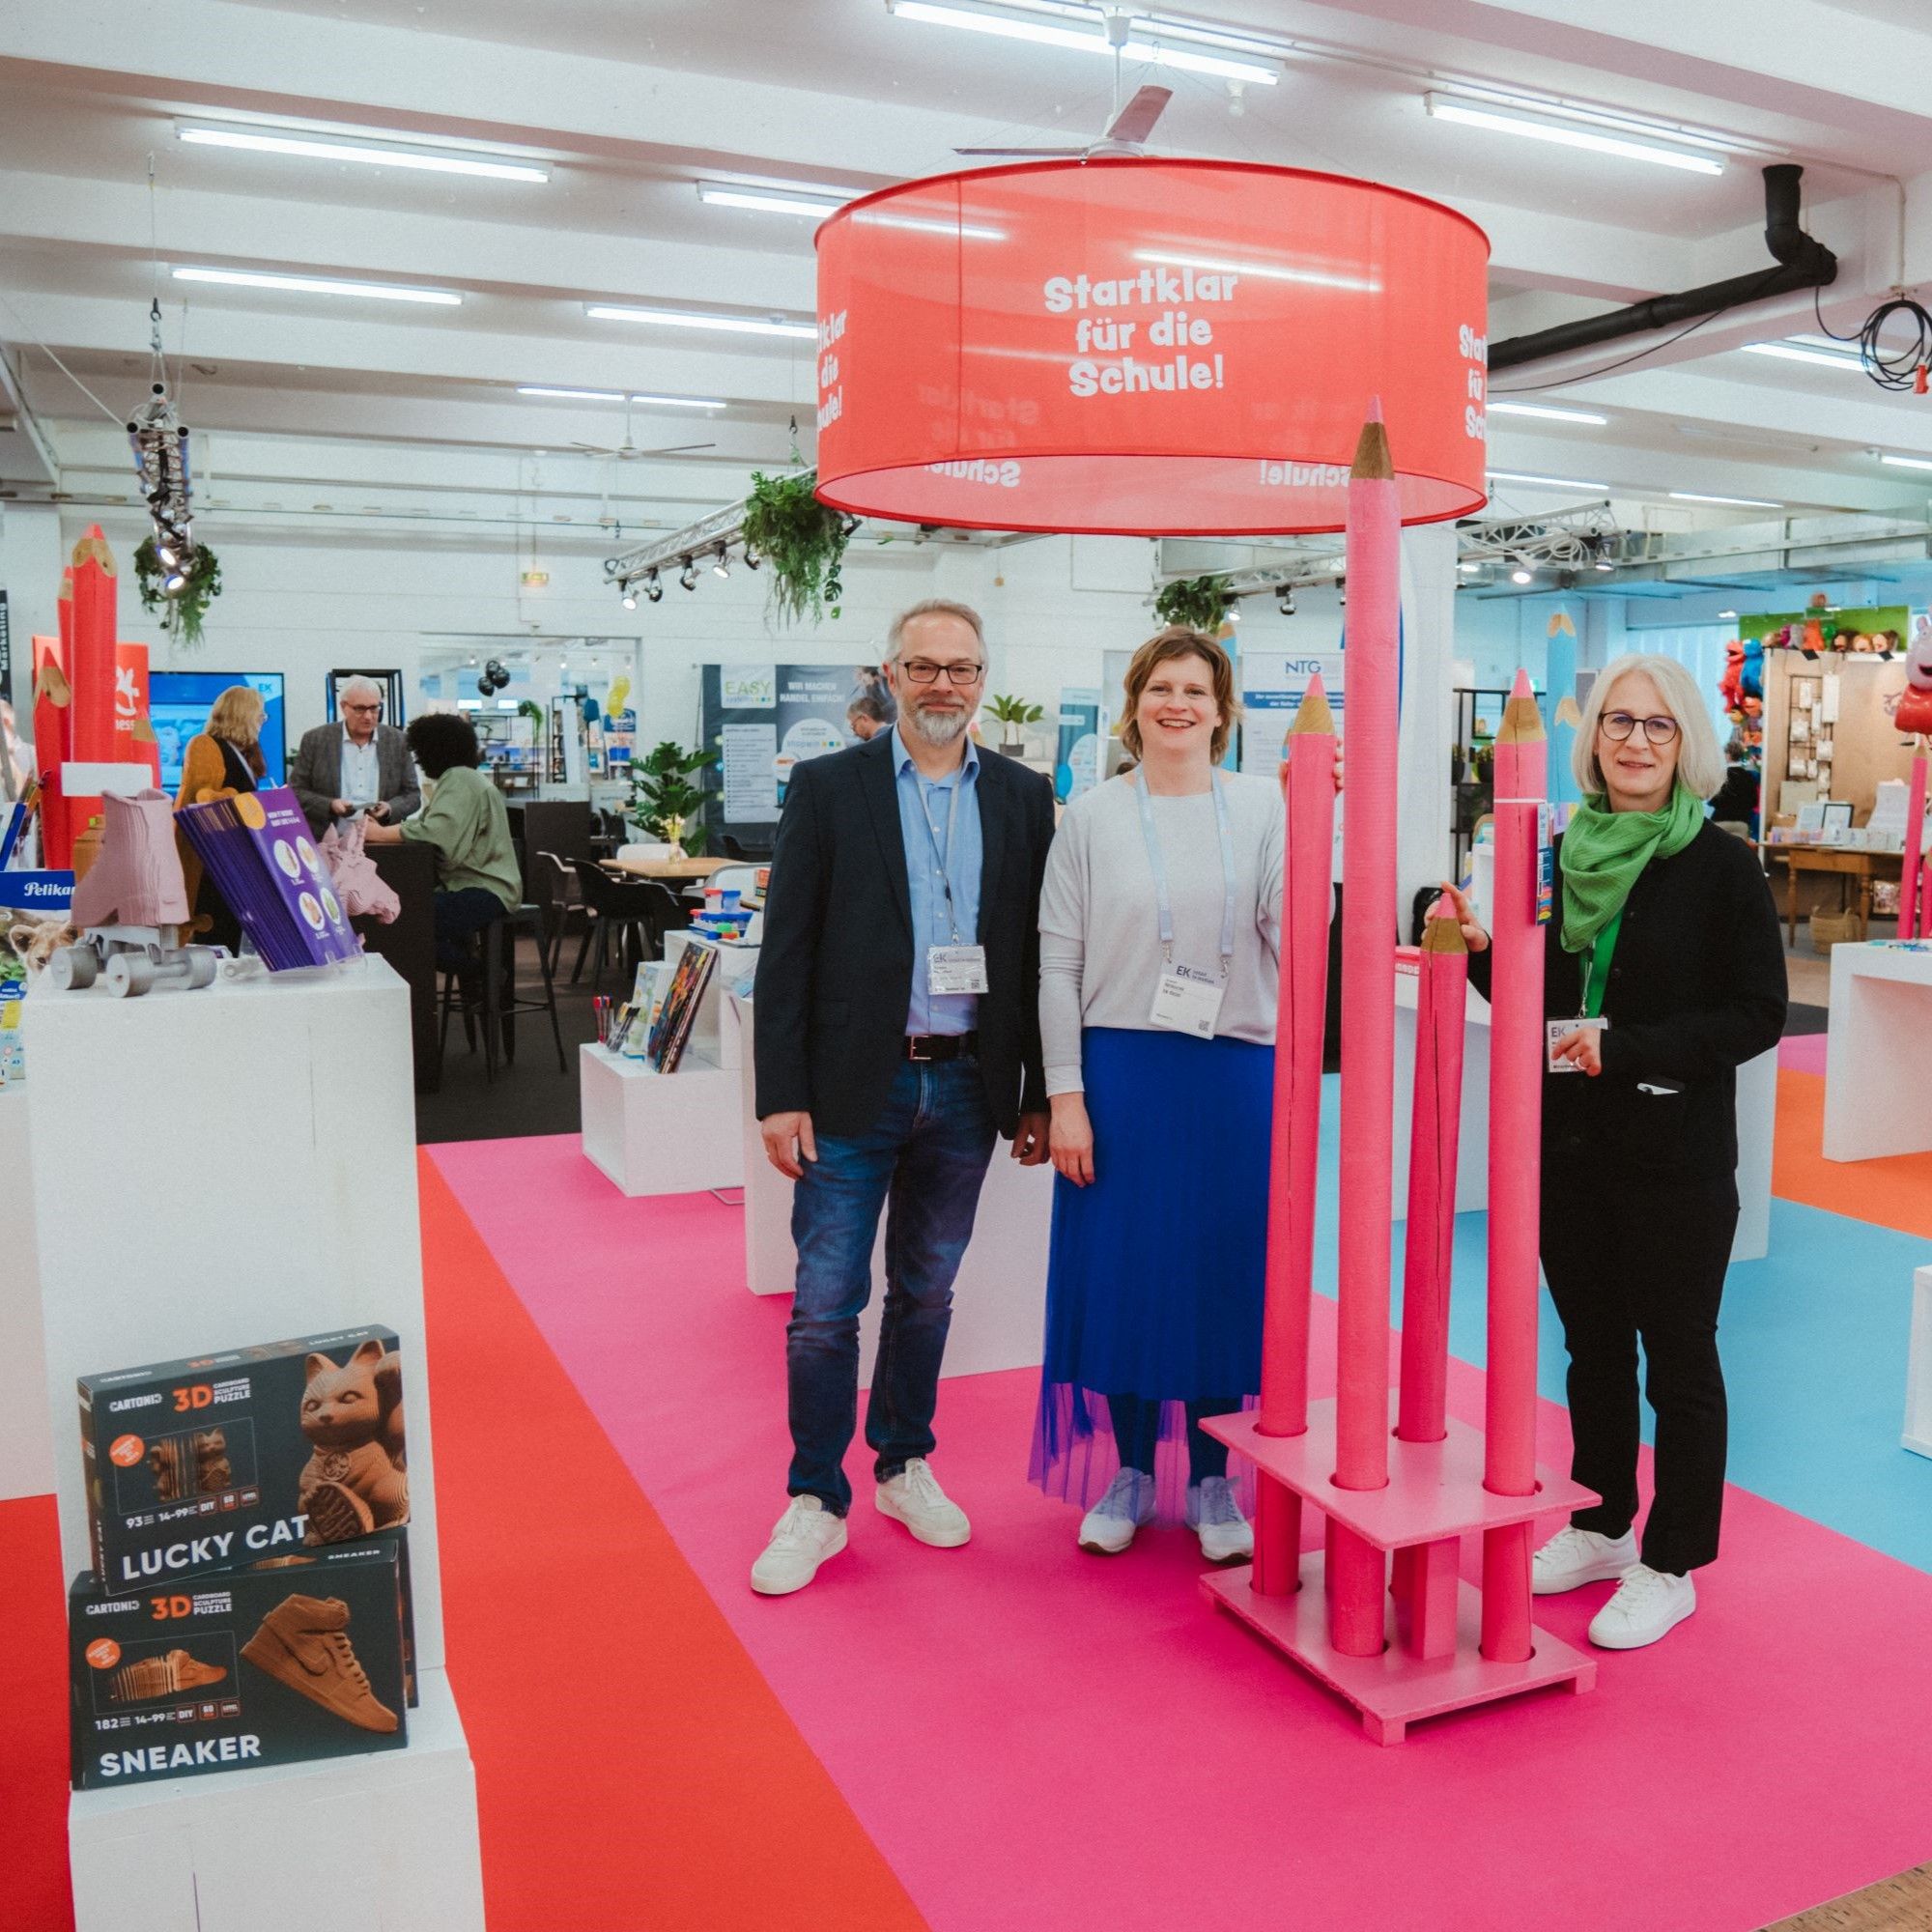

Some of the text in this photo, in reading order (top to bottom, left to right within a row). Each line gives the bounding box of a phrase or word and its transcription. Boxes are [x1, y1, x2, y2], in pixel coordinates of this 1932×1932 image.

[1044, 268, 1238, 313] Startklar
[1075, 311, 1213, 353] für die
[1068, 354, 1224, 397] Schule!
[1286, 661, 1321, 673] NTG
[725, 681, 771, 695] EASY
[1176, 965, 1192, 979] EK
[1551, 1027, 1565, 1037] EK
[172, 1383, 213, 1412] 3D
[213, 1389, 251, 1405] PUZZLE
[126, 1517, 144, 1529] 93
[123, 1514, 310, 1580] LUCKY CAT
[327, 1549, 381, 1560] SNEAKER
[150, 1595, 191, 1620] 3D
[193, 1604, 233, 1615] PUZZLE
[179, 1709, 194, 1719] DIY
[95, 1719, 119, 1730] 182
[99, 1734, 262, 1776] SNEAKER
